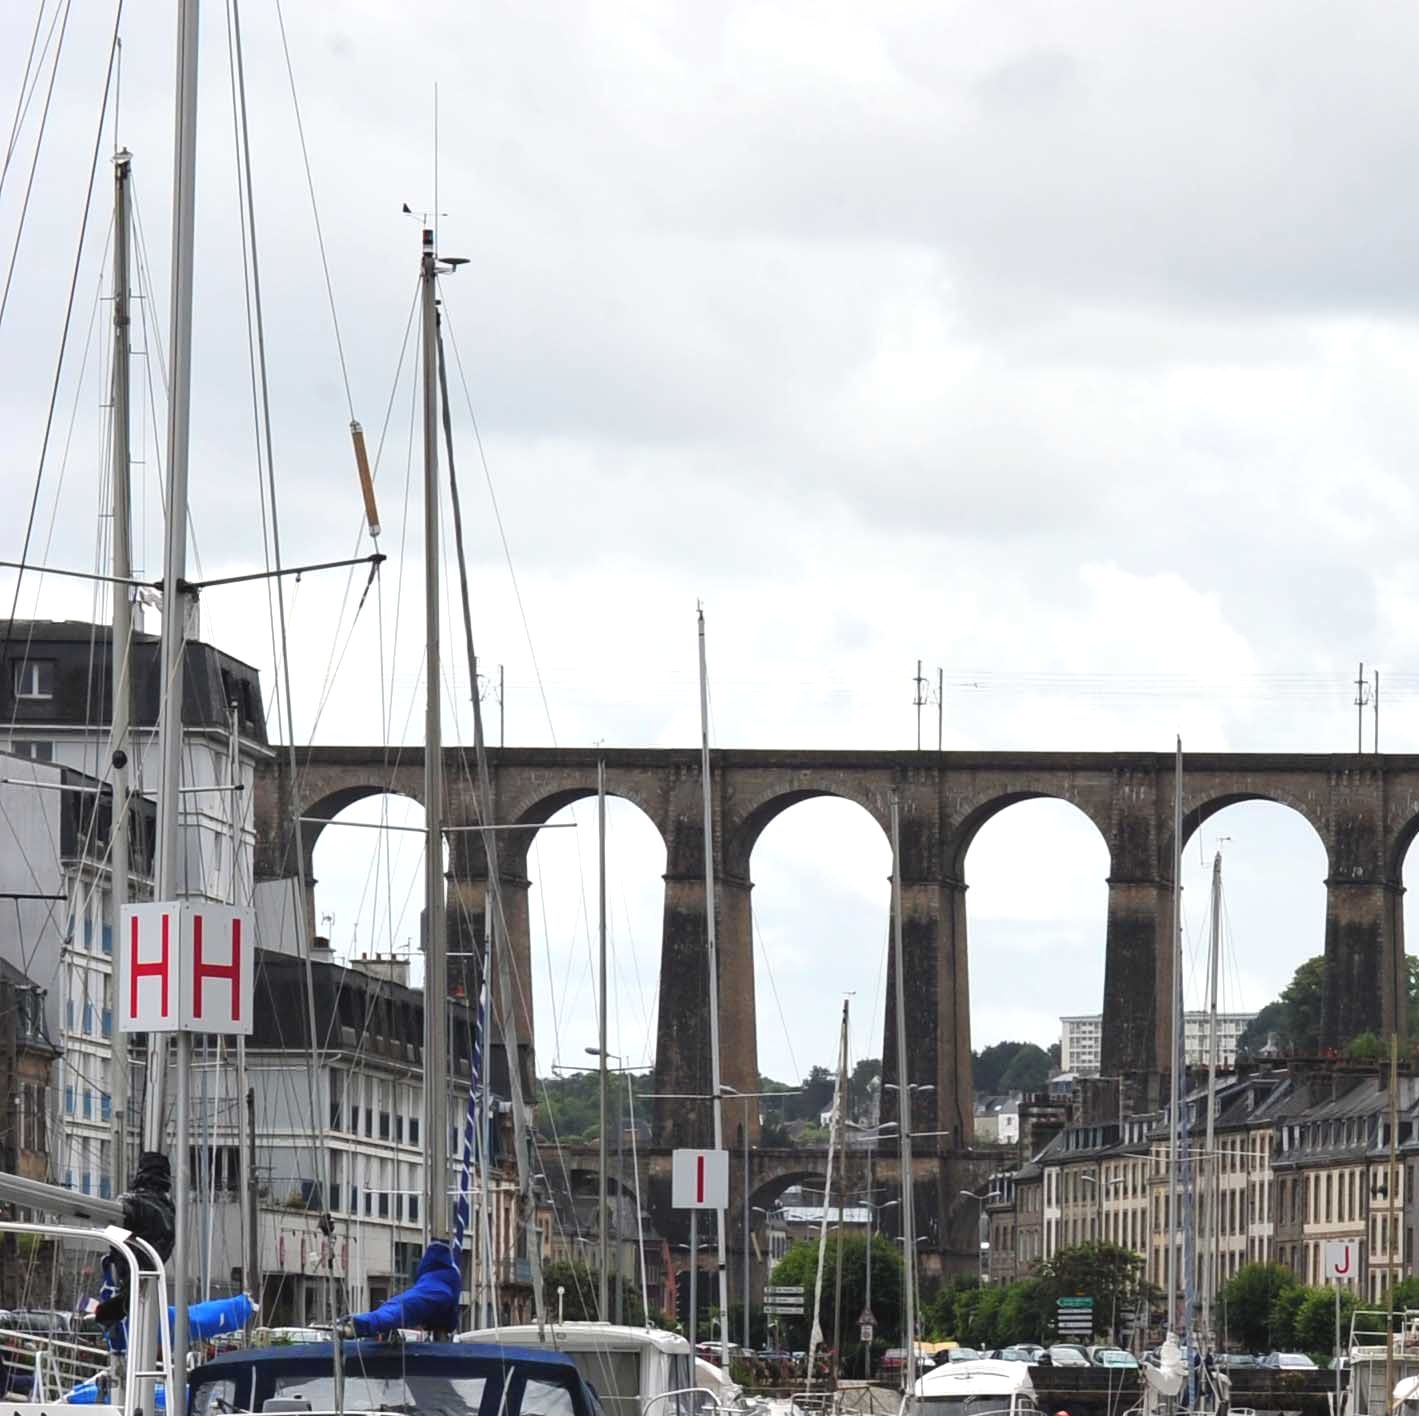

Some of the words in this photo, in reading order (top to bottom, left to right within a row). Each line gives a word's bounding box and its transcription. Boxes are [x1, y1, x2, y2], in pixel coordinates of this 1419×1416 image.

[131, 914, 168, 1018] H
[193, 915, 241, 1021] H
[1335, 1245, 1350, 1274] J
